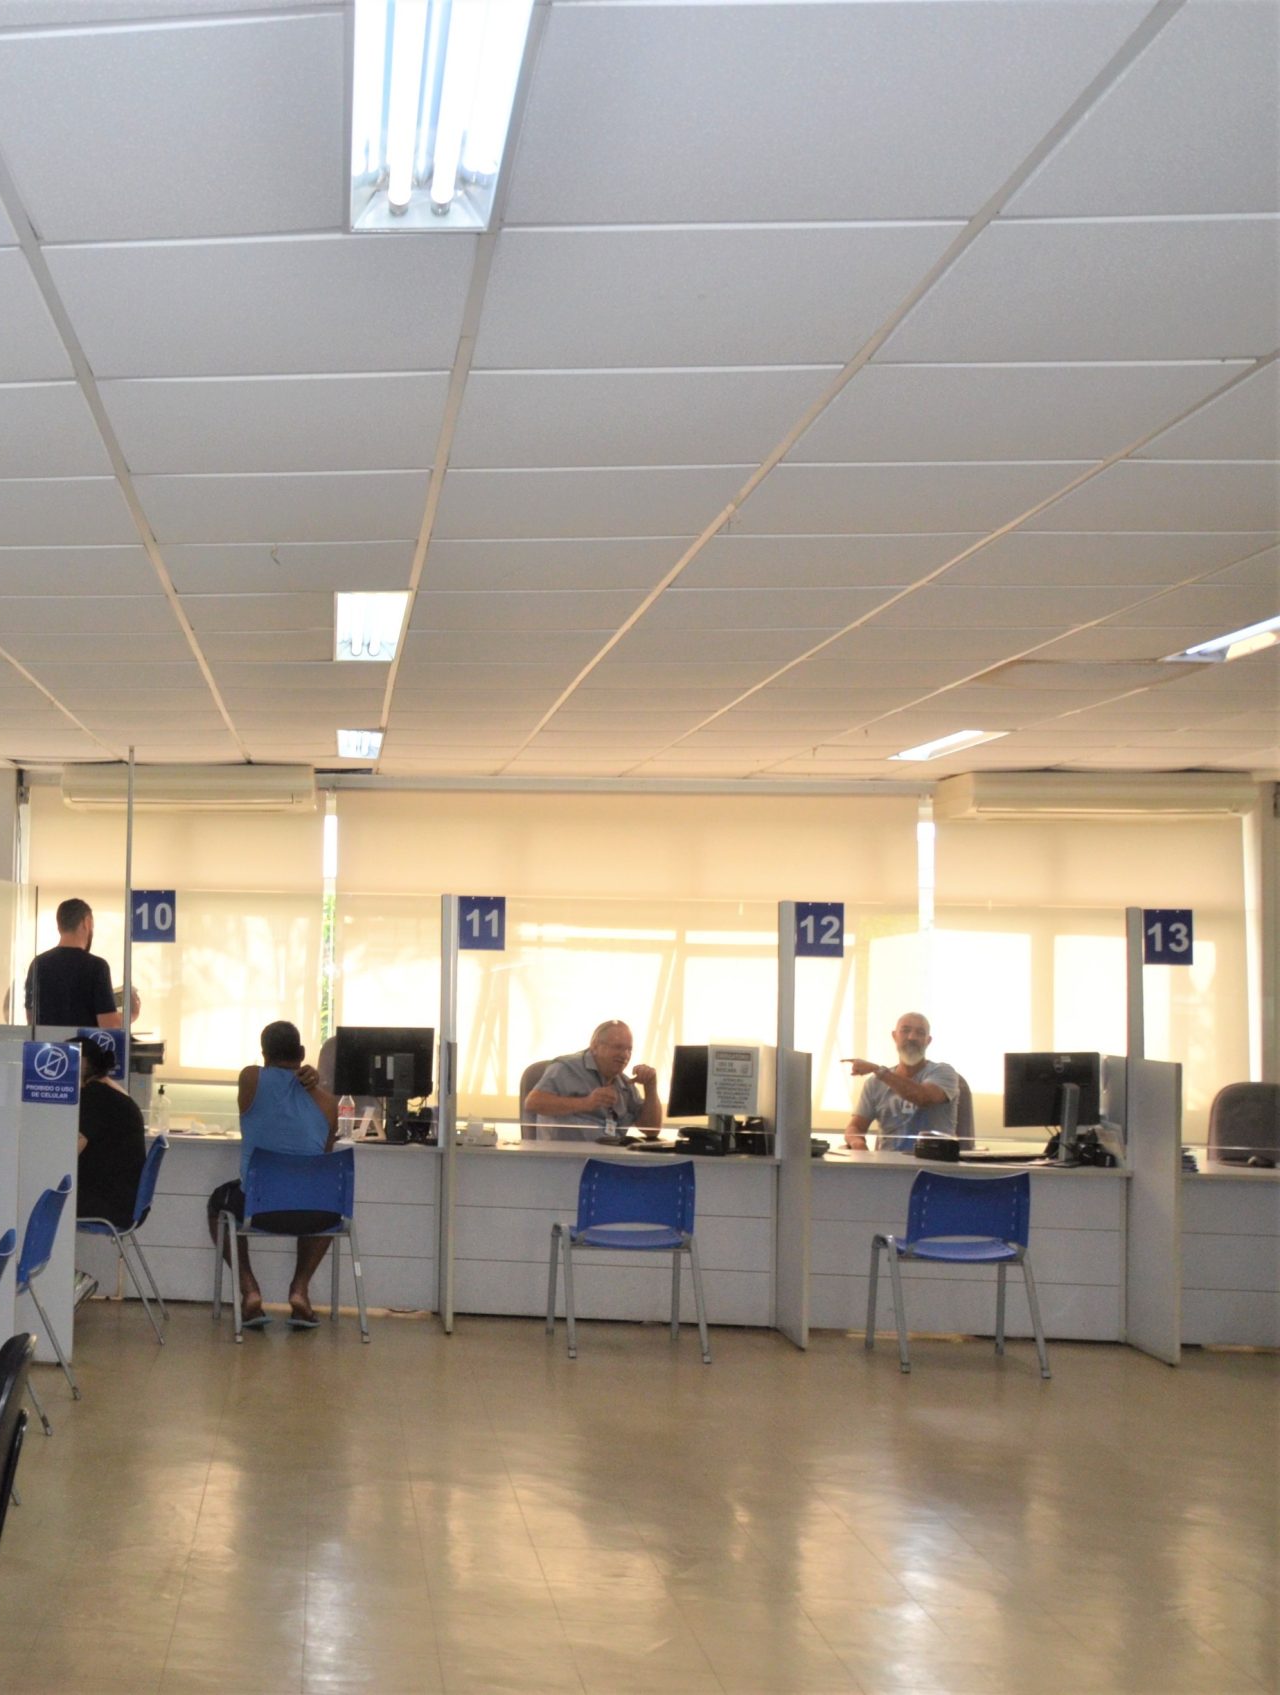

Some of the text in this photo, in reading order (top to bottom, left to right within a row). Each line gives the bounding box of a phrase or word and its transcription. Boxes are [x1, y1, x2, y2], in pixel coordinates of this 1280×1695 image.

[136, 902, 172, 930] 10
[466, 909, 498, 937] 11
[800, 915, 840, 944] 12
[1147, 922, 1189, 952] 13
[25, 1084, 54, 1092] PROIBIDO
